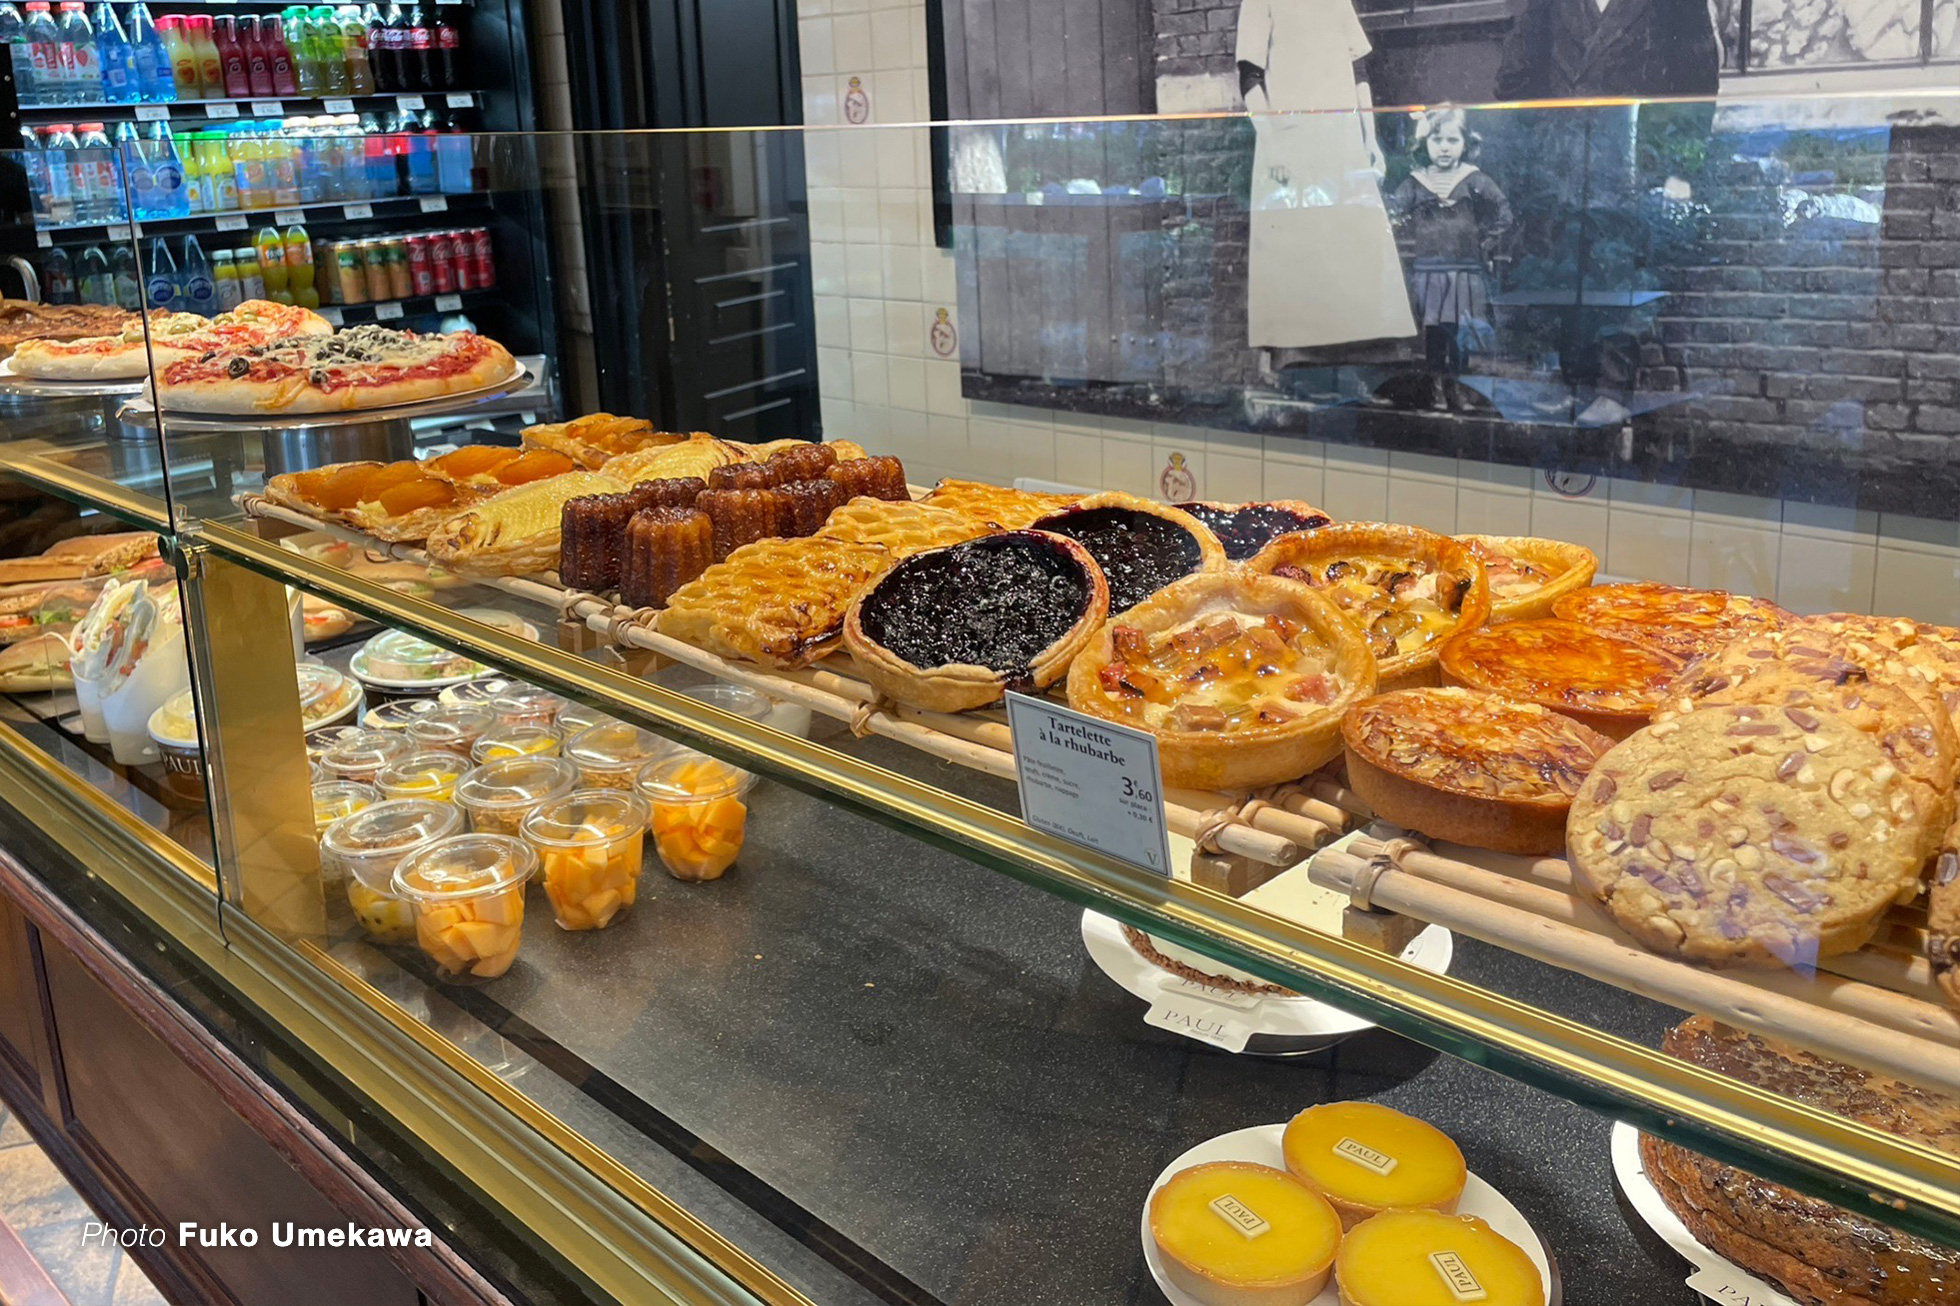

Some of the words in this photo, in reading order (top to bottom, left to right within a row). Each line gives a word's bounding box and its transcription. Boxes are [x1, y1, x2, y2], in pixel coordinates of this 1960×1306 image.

[1047, 716, 1112, 747] Tartelette
[1039, 728, 1047, 741] à
[1049, 732, 1061, 746] la
[1065, 738, 1126, 766] rhubarbe
[1163, 1010, 1228, 1038] PAUL
[1347, 1142, 1384, 1165] PAUL
[1225, 1199, 1259, 1225] PAUL
[1443, 1255, 1473, 1287] PAUL
